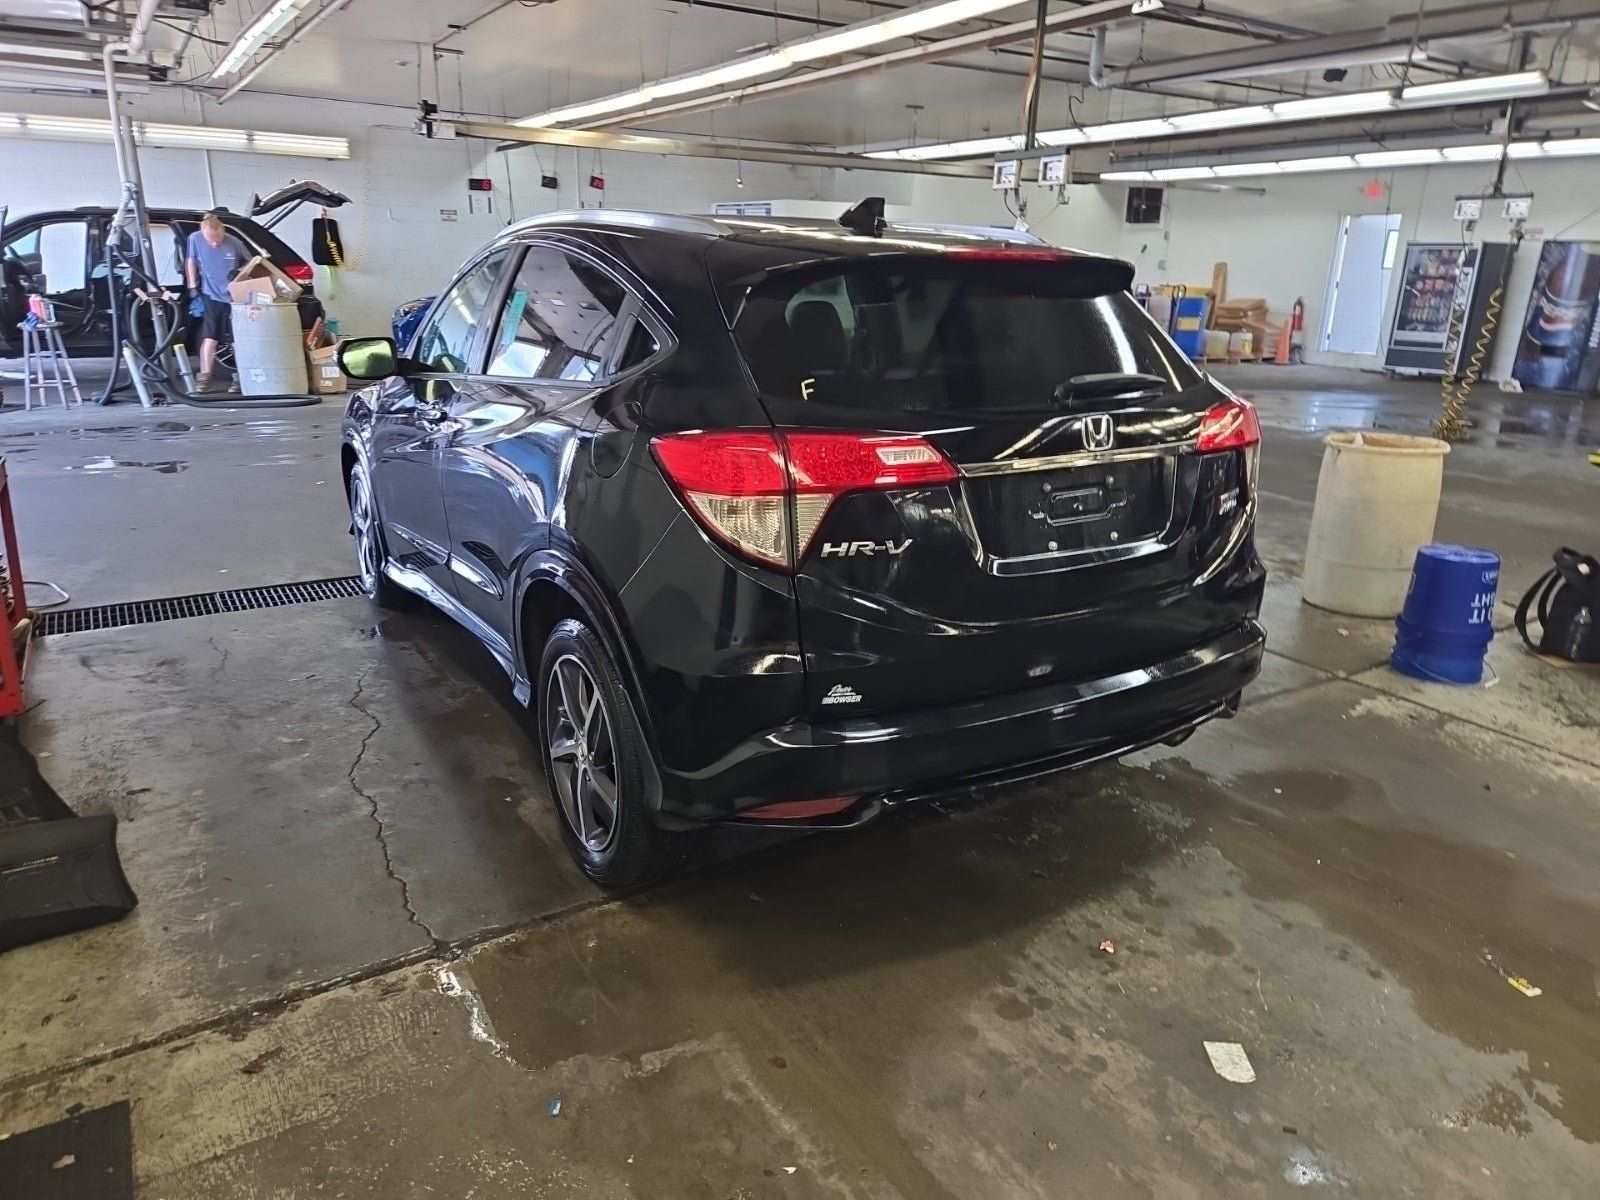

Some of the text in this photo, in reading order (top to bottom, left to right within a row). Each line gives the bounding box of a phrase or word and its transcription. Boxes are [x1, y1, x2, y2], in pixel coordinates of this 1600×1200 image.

[800, 378, 816, 401] F
[820, 538, 913, 558] HR-V
[826, 695, 863, 705] BOWSER
